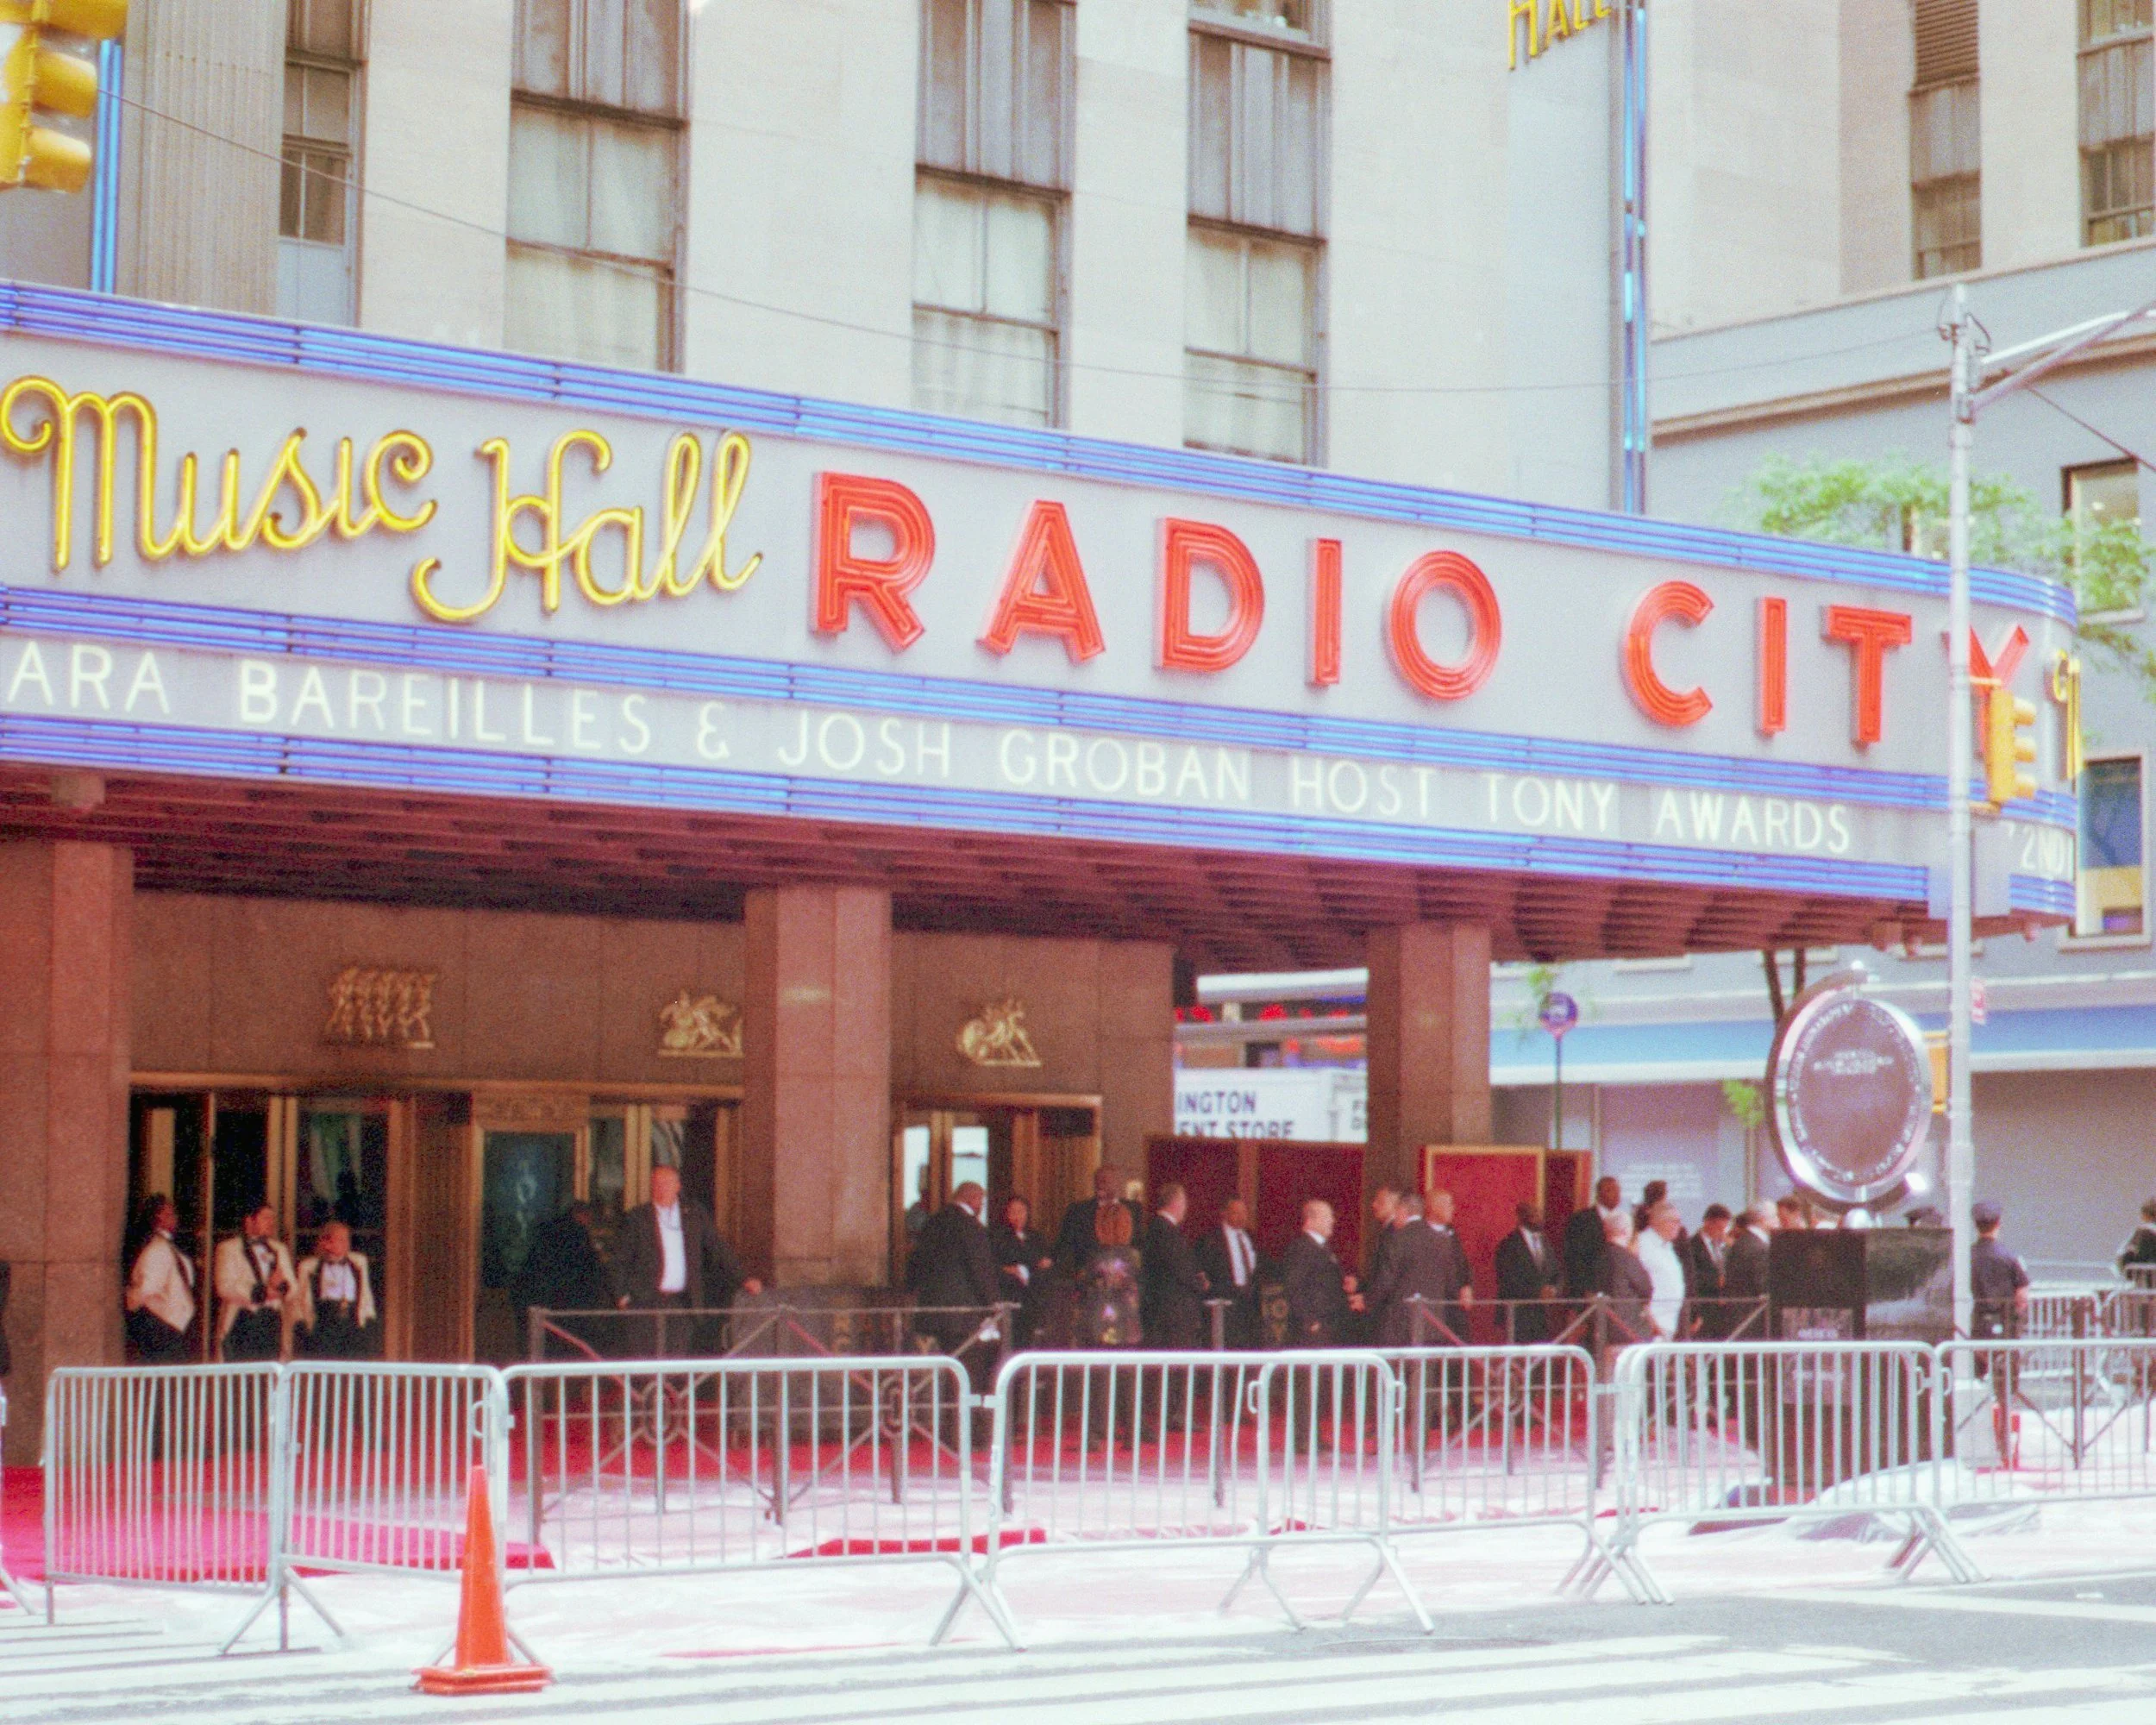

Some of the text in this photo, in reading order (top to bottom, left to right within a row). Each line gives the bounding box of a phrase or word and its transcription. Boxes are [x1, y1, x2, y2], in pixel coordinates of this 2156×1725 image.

[1, 375, 763, 623] Music Hall
[812, 471, 1502, 701] RADIO
[1622, 580, 2030, 759] CITY
[7, 640, 1851, 855] ARA BAREILLES & JOSH GROBAN HOST TONY AWARDS
